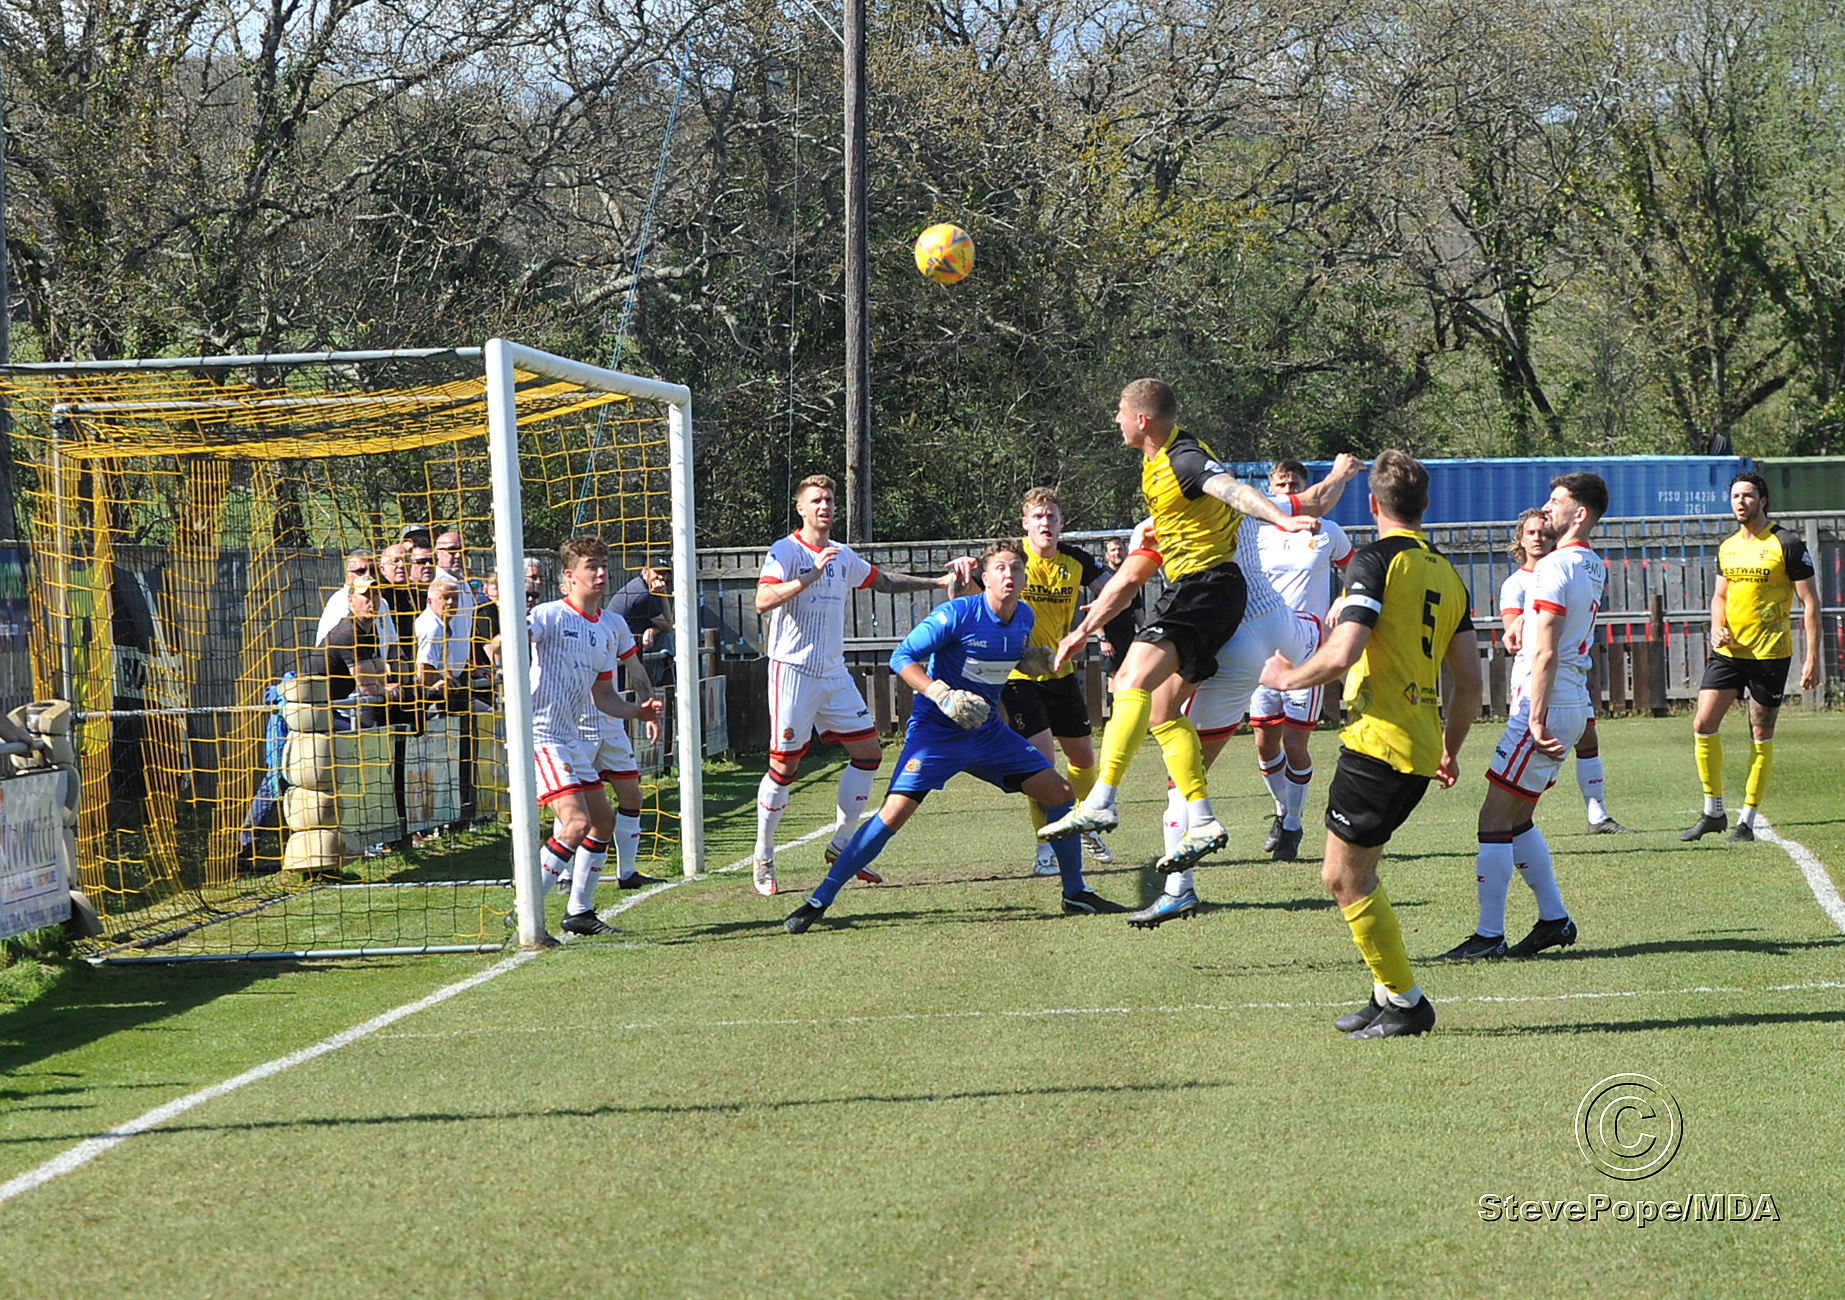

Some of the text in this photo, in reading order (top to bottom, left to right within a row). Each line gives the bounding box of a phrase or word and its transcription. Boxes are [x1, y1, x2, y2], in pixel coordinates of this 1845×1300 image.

[825, 563, 835, 578] 18
[1724, 567, 1770, 576] ESTWARD
[1023, 584, 1074, 595] ESTWARD
[1422, 589, 1441, 659] 5
